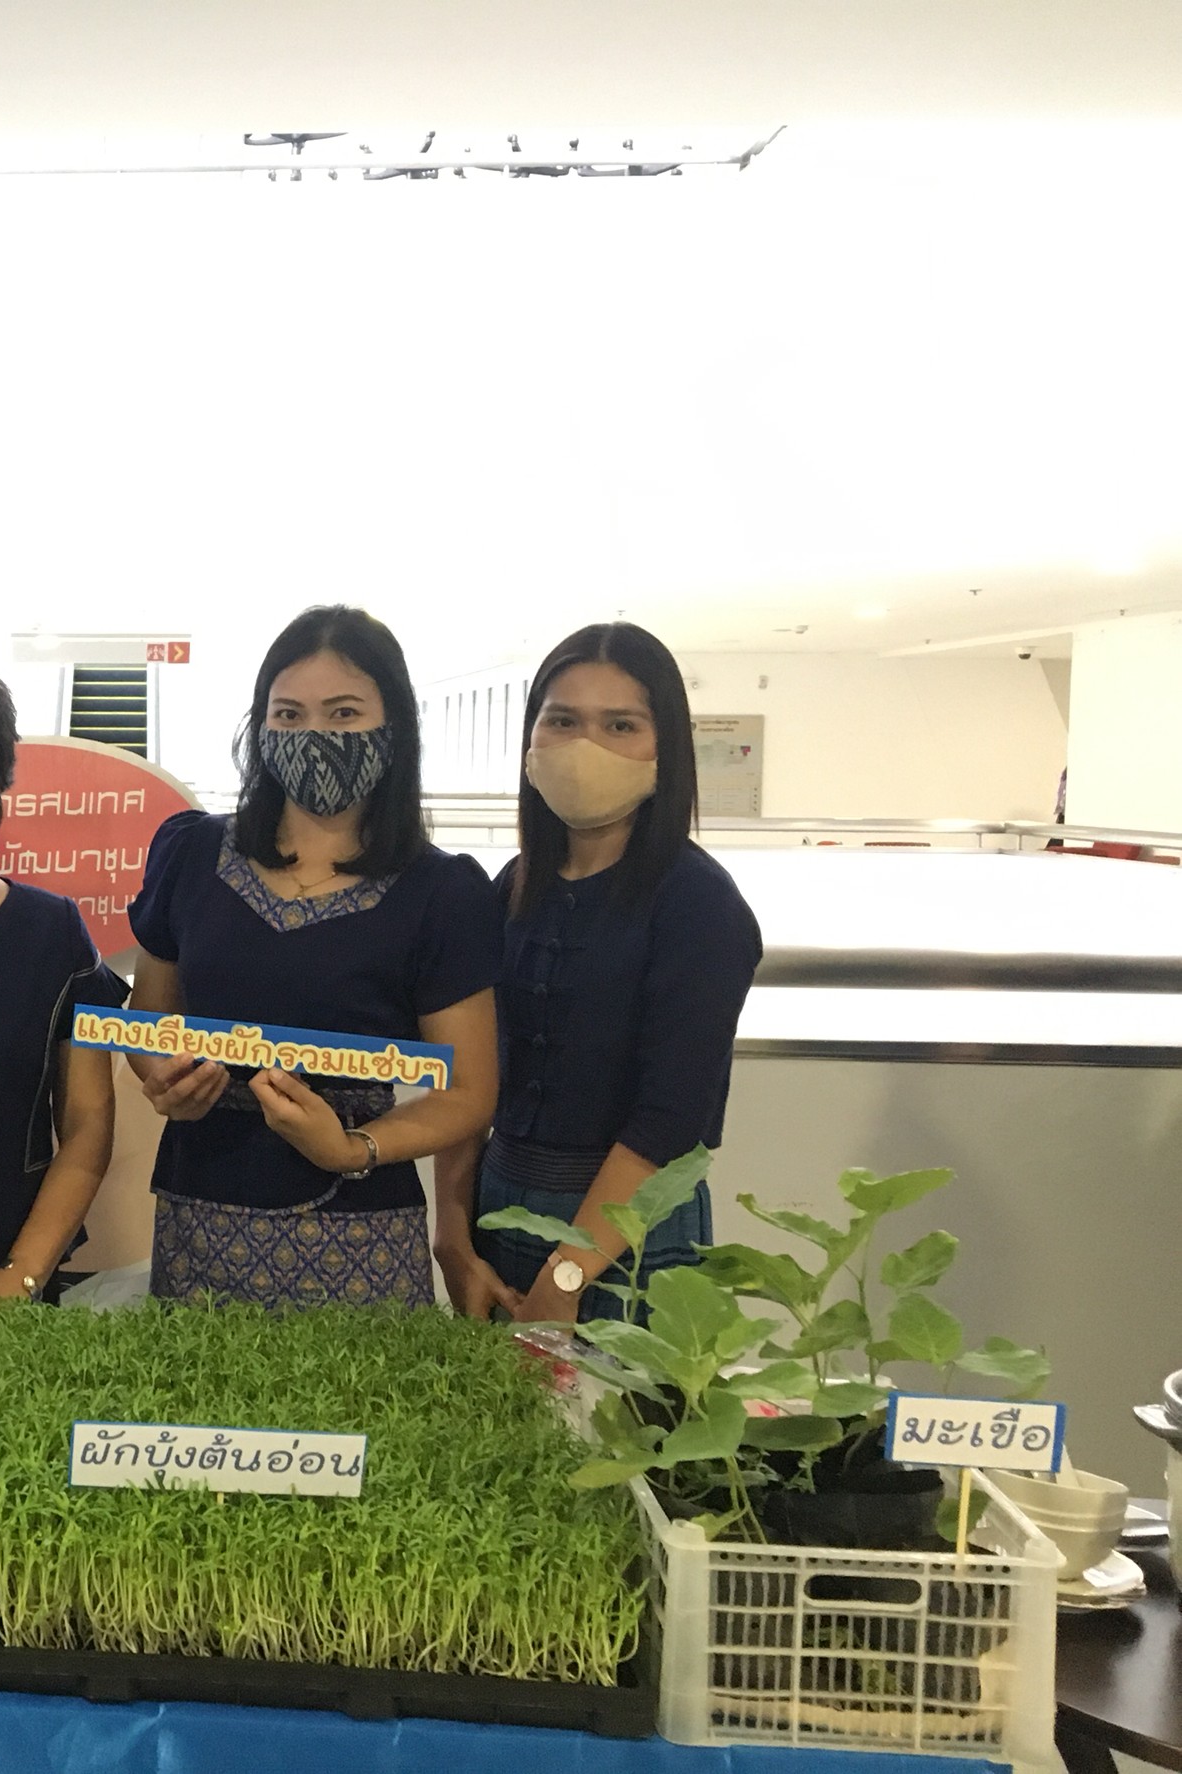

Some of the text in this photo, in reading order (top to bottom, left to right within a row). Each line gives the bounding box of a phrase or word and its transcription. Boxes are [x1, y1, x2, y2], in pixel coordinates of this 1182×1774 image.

[902, 1408, 1051, 1451] มะเขือ
[80, 1429, 361, 1478] ผักบุ้งต้นอ่อน
